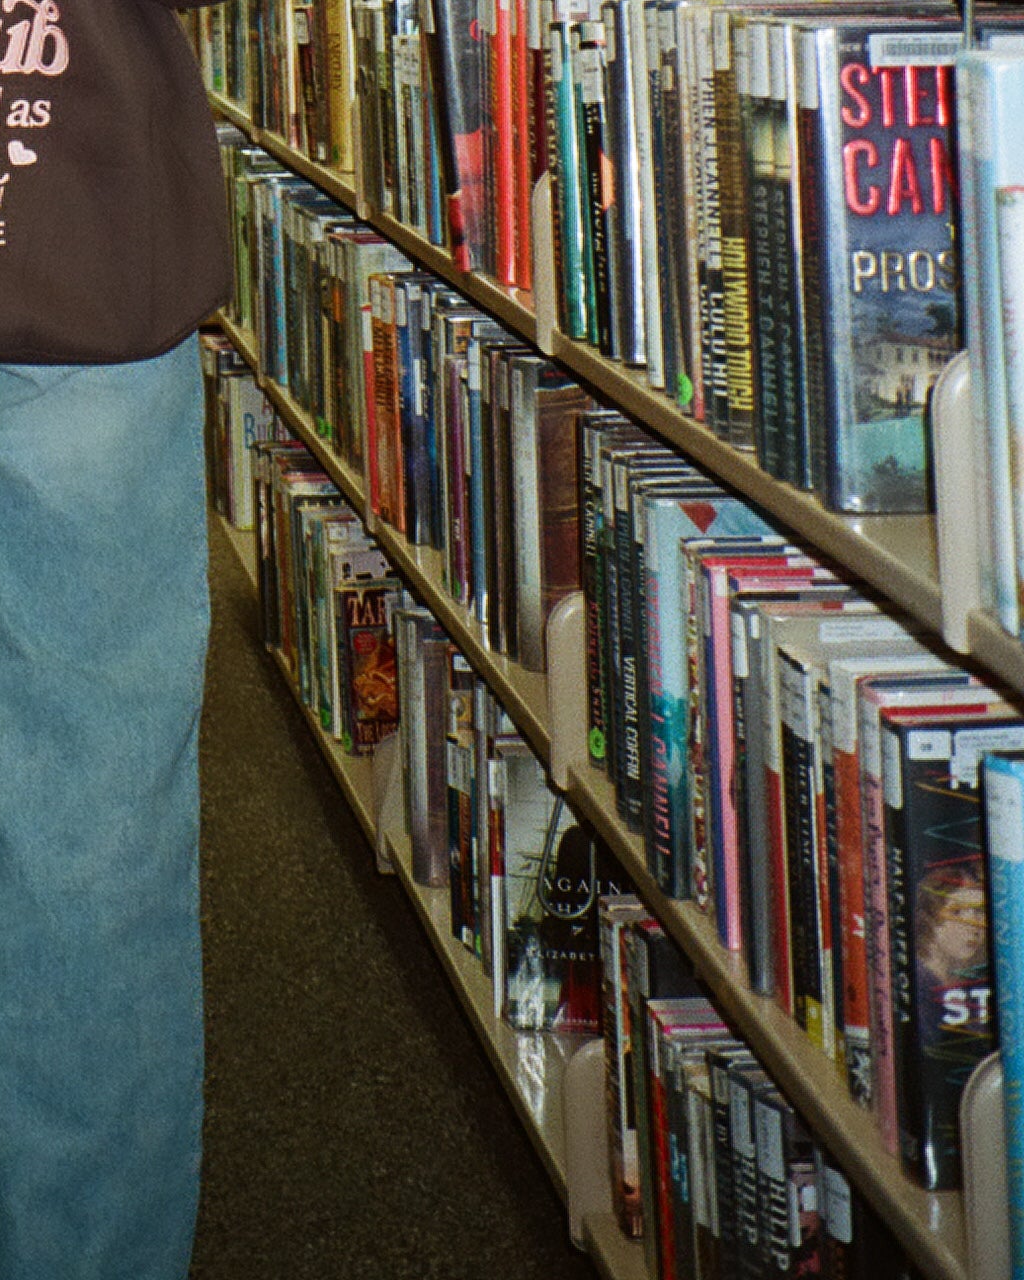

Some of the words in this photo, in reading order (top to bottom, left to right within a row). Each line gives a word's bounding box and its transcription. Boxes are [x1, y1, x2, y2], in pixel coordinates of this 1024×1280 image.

[6, 99, 51, 127] as
[705, 155, 723, 267] CANNELL
[754, 184, 773, 285] STEPHEN
[772, 188, 789, 292] STEPHEN
[709, 291, 727, 355] COLD
[722, 236, 751, 348] HOLLYWOOD
[758, 292, 774, 311] J
[712, 361, 729, 399] HIT
[726, 349, 756, 412] TOUGH
[759, 314, 779, 433] CANNELL
[778, 320, 797, 442] CANNELL
[619, 576, 635, 642] CANNELL
[644, 575, 664, 699] STEPHEN
[622, 655, 638, 724] VERTICAL
[626, 725, 641, 782] COFFIN
[650, 734, 672, 858] CANNELL
